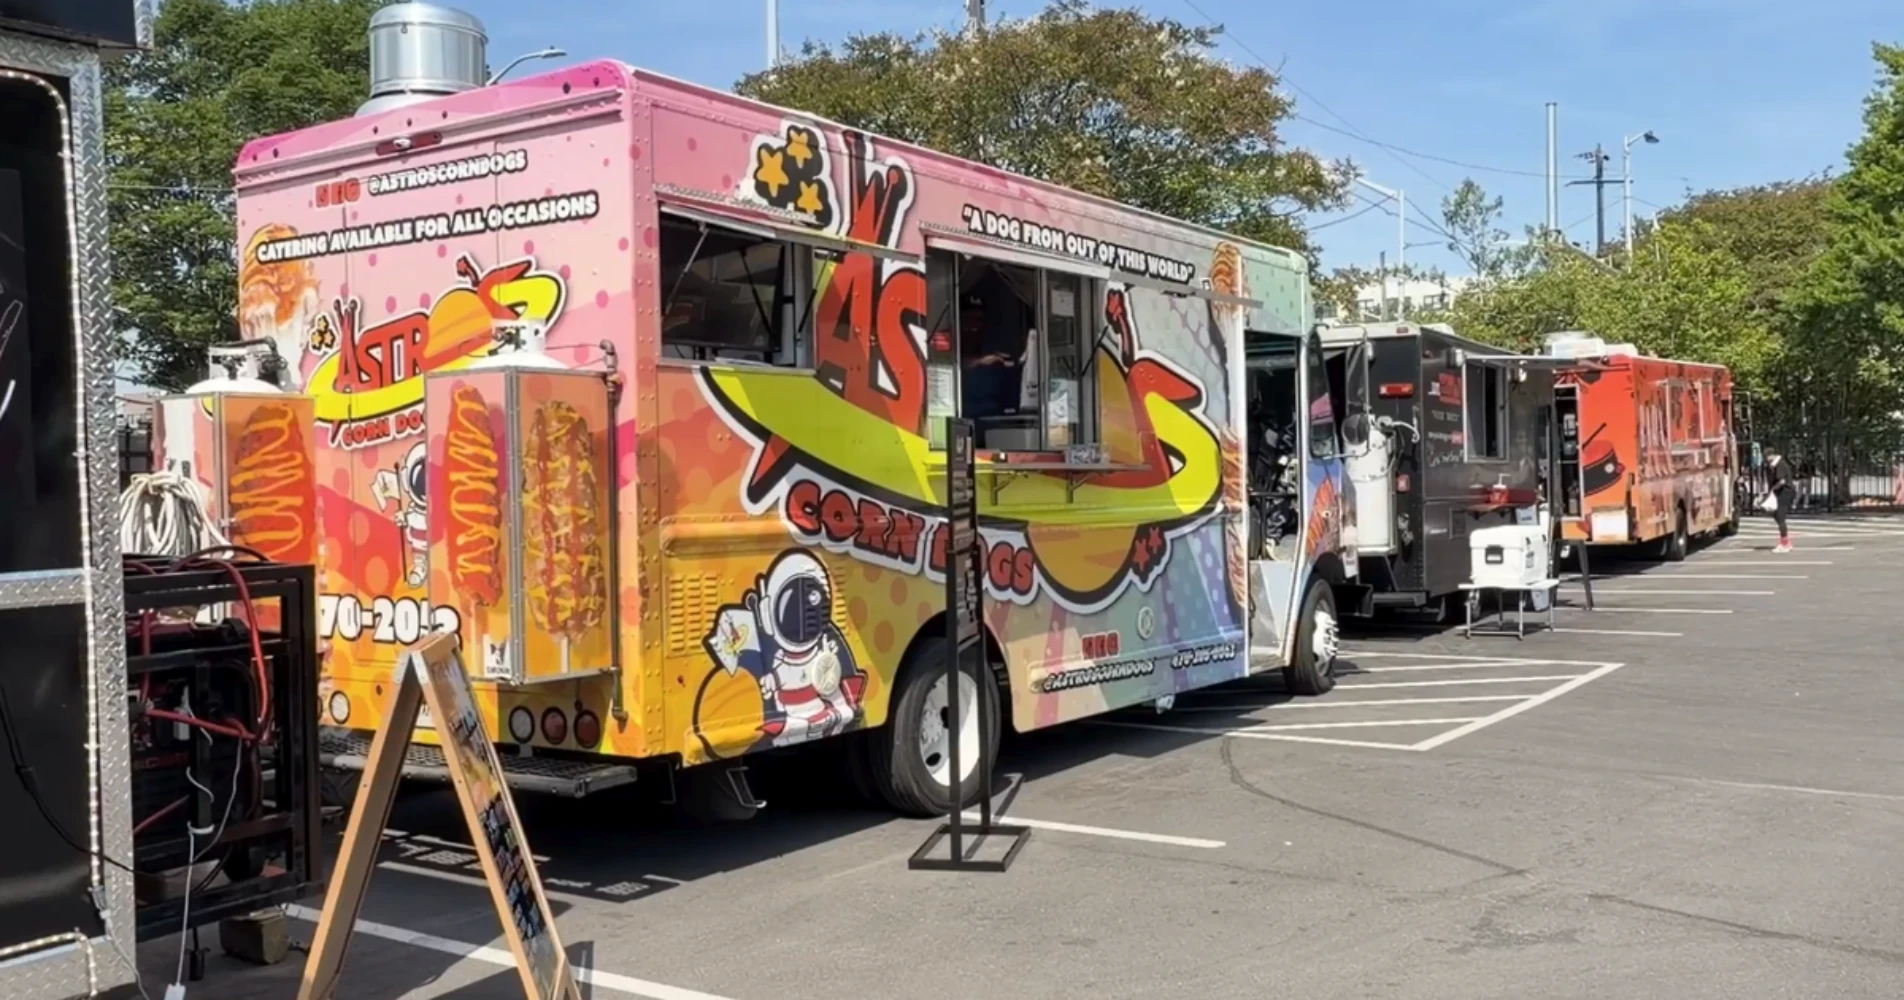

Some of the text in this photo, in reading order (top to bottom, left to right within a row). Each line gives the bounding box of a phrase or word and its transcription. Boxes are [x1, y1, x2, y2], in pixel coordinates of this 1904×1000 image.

[368, 149, 527, 195] @ASTROSCORNDOGS
[256, 192, 599, 263] CATERING AVAILABLE FOR ALL OCCASIONS
[985, 211, 1021, 242] DOG
[1022, 220, 1064, 252] FROM
[1065, 232, 1097, 260] OUT
[1098, 241, 1117, 265] OF
[1117, 246, 1147, 273] THIS
[342, 415, 391, 446] CORN
[786, 480, 925, 565] CORN
